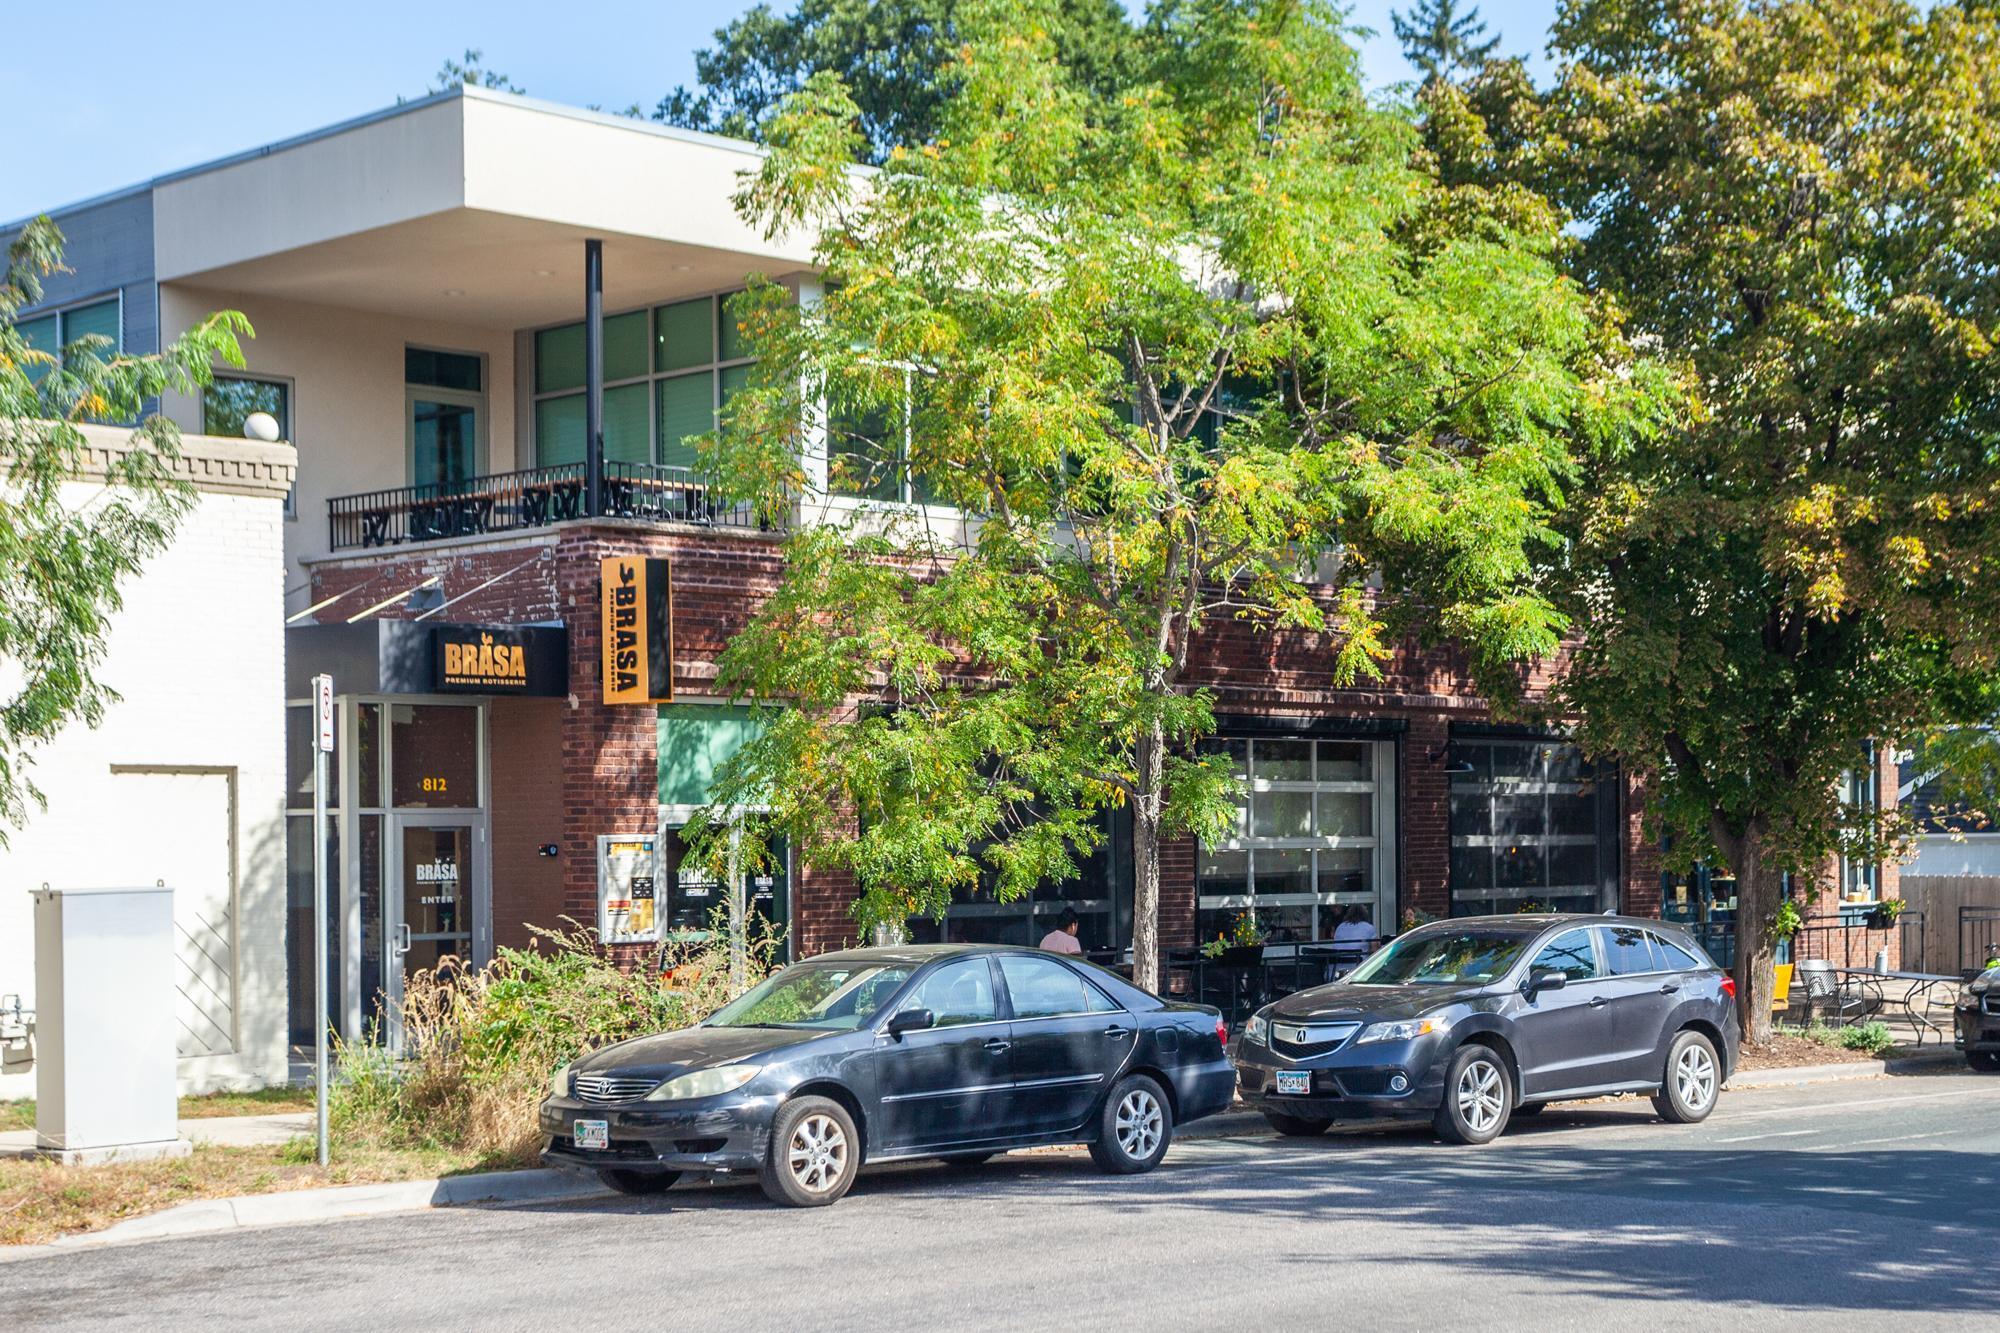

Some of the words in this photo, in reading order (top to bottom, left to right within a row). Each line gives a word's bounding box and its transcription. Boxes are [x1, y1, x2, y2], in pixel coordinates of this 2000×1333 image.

[445, 676, 481, 685] PREMIUM
[482, 678, 527, 686] ROTISSERIE
[422, 778, 447, 792] 812
[421, 896, 454, 904] ENTER
